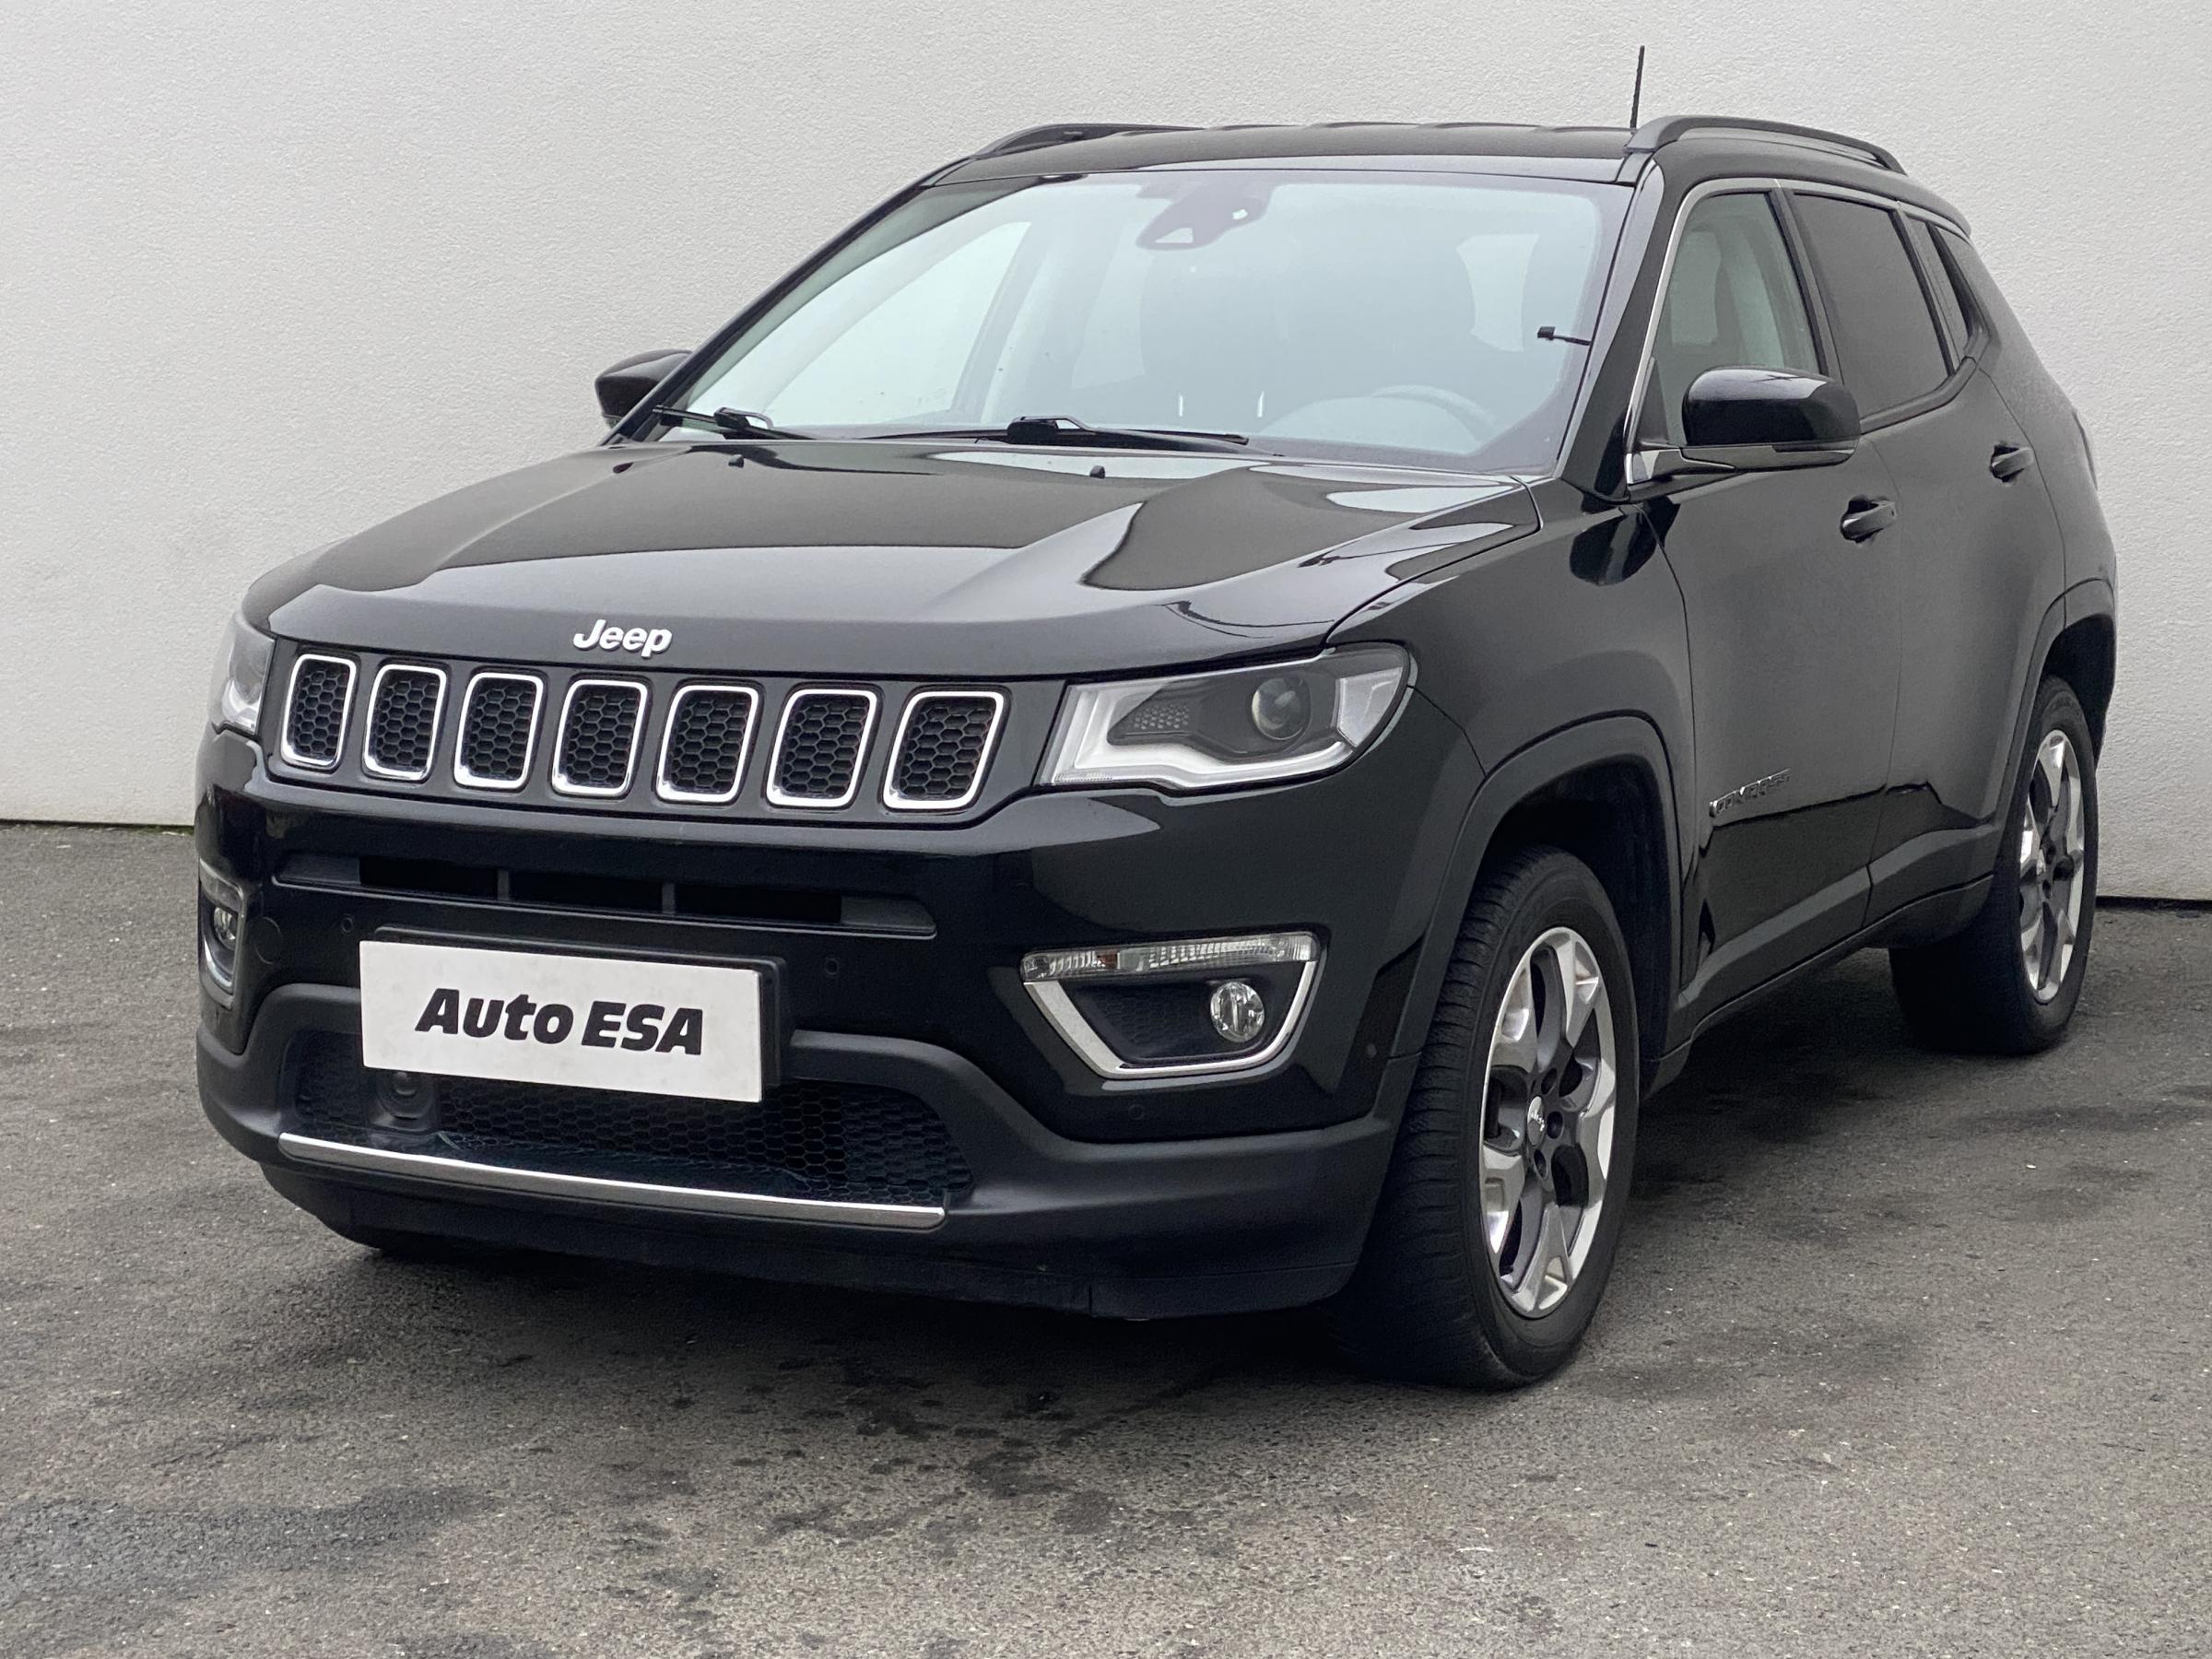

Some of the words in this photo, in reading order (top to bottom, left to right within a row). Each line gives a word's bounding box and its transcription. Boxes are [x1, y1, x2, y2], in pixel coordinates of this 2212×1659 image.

[572, 618, 673, 659] Jeep
[415, 988, 574, 1044] Auto
[581, 1000, 703, 1055] ESA
